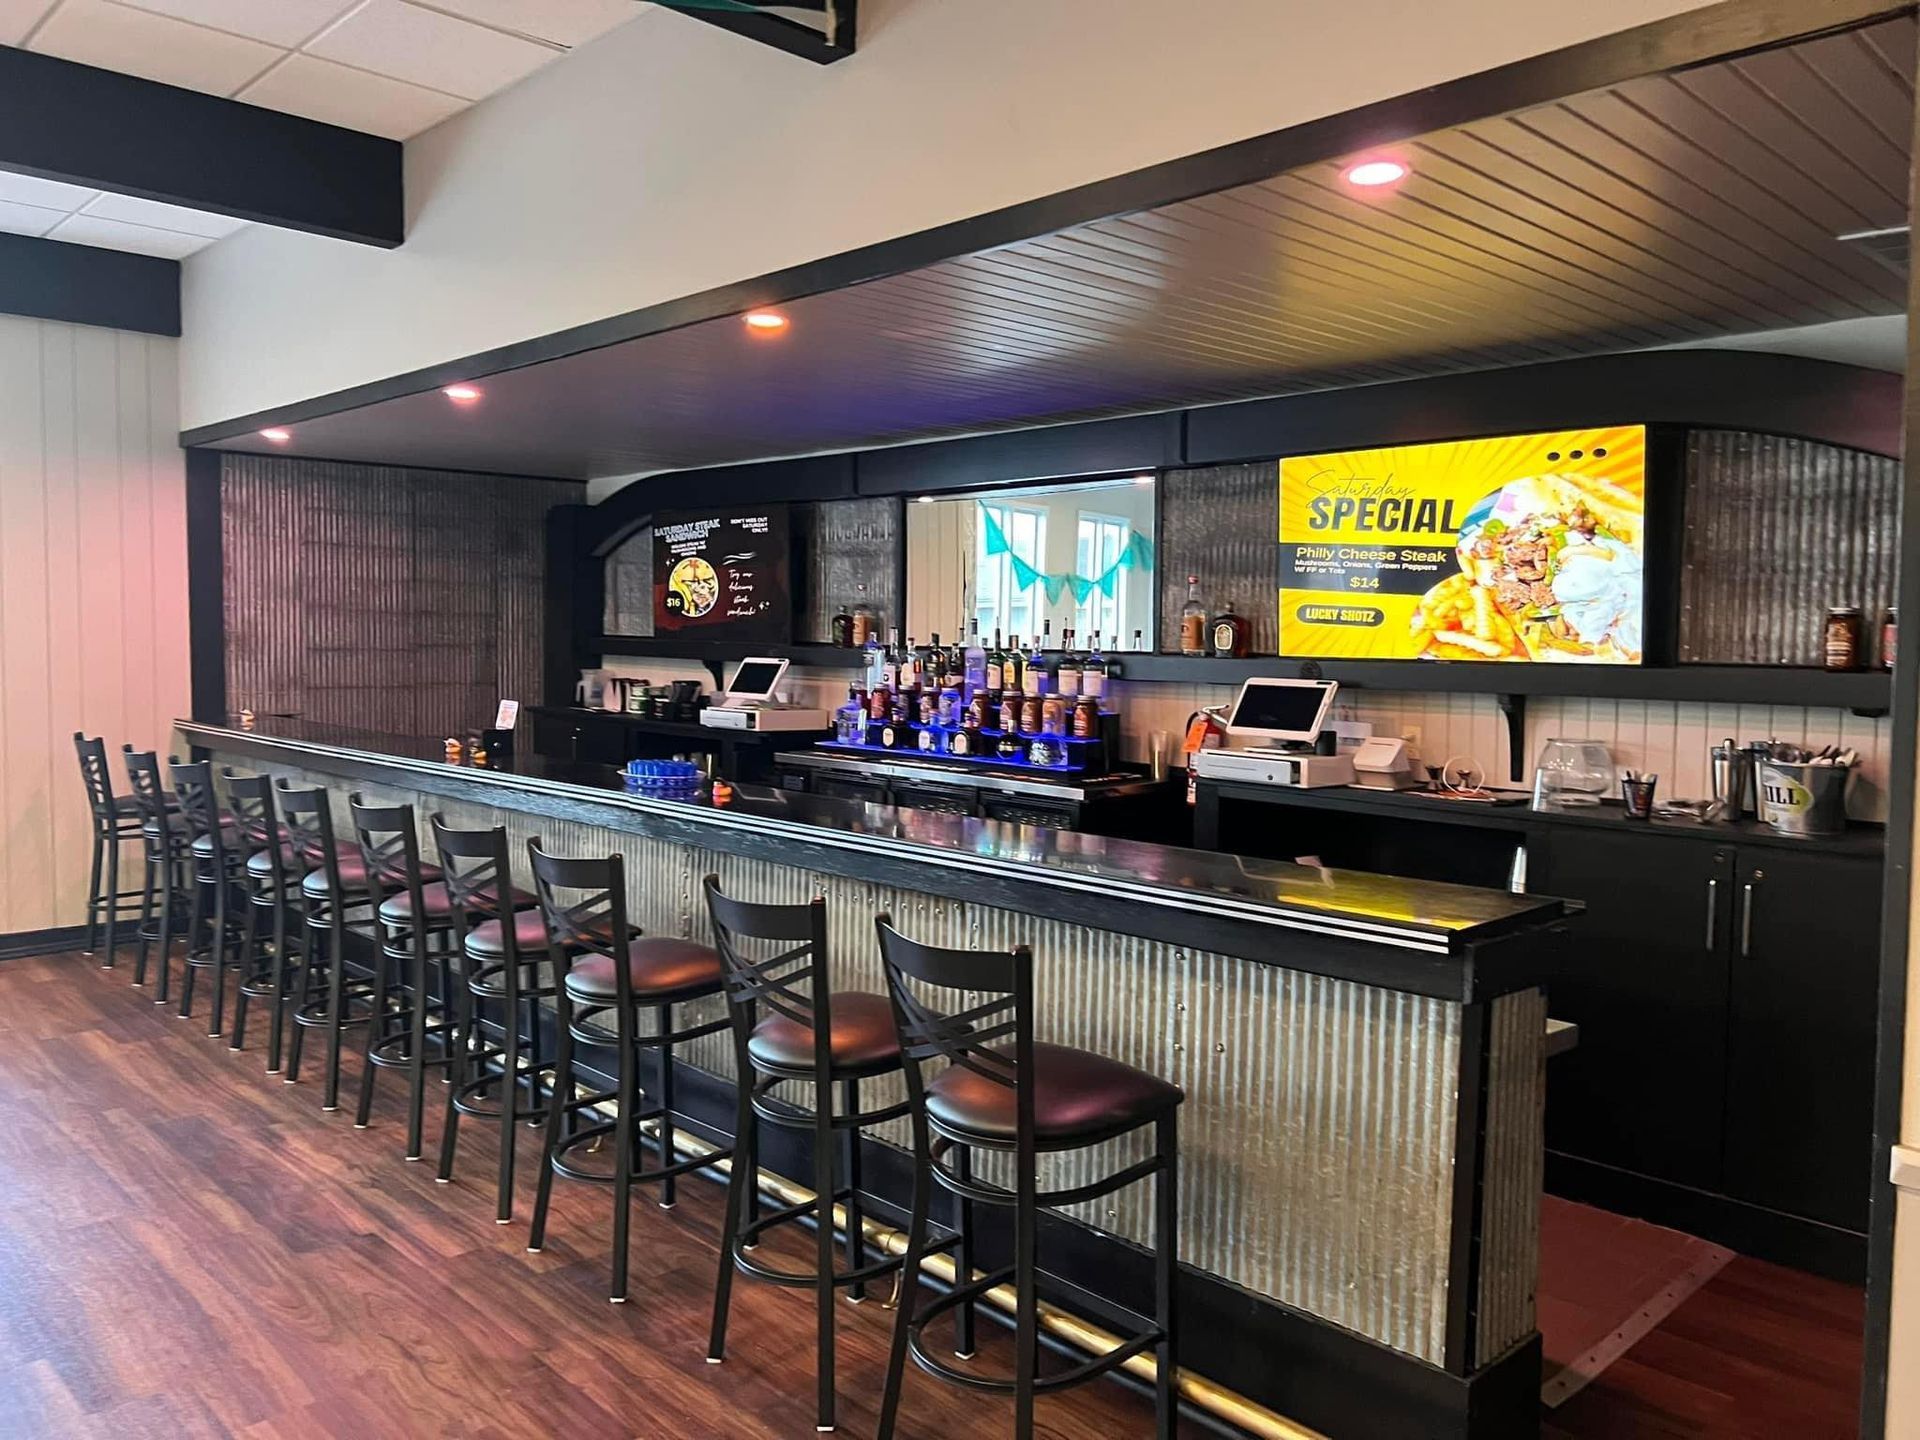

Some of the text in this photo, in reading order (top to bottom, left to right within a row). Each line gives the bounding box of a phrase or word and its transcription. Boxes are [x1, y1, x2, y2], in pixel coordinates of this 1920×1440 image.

[1306, 470, 1416, 508] Saturday
[1309, 497, 1459, 533] SPECIAL
[654, 518, 720, 536] SATURDAY STEAK
[665, 529, 708, 543] SANDWICH
[1296, 546, 1447, 563] Philly Cheese Steak
[1294, 559, 1438, 572] Mushrooms, Onions, Green Peppers
[1328, 567, 1346, 575] Tots
[1349, 576, 1380, 589] $14
[666, 597, 681, 608] $16
[1305, 607, 1375, 622] LUCKY SHOTZ
